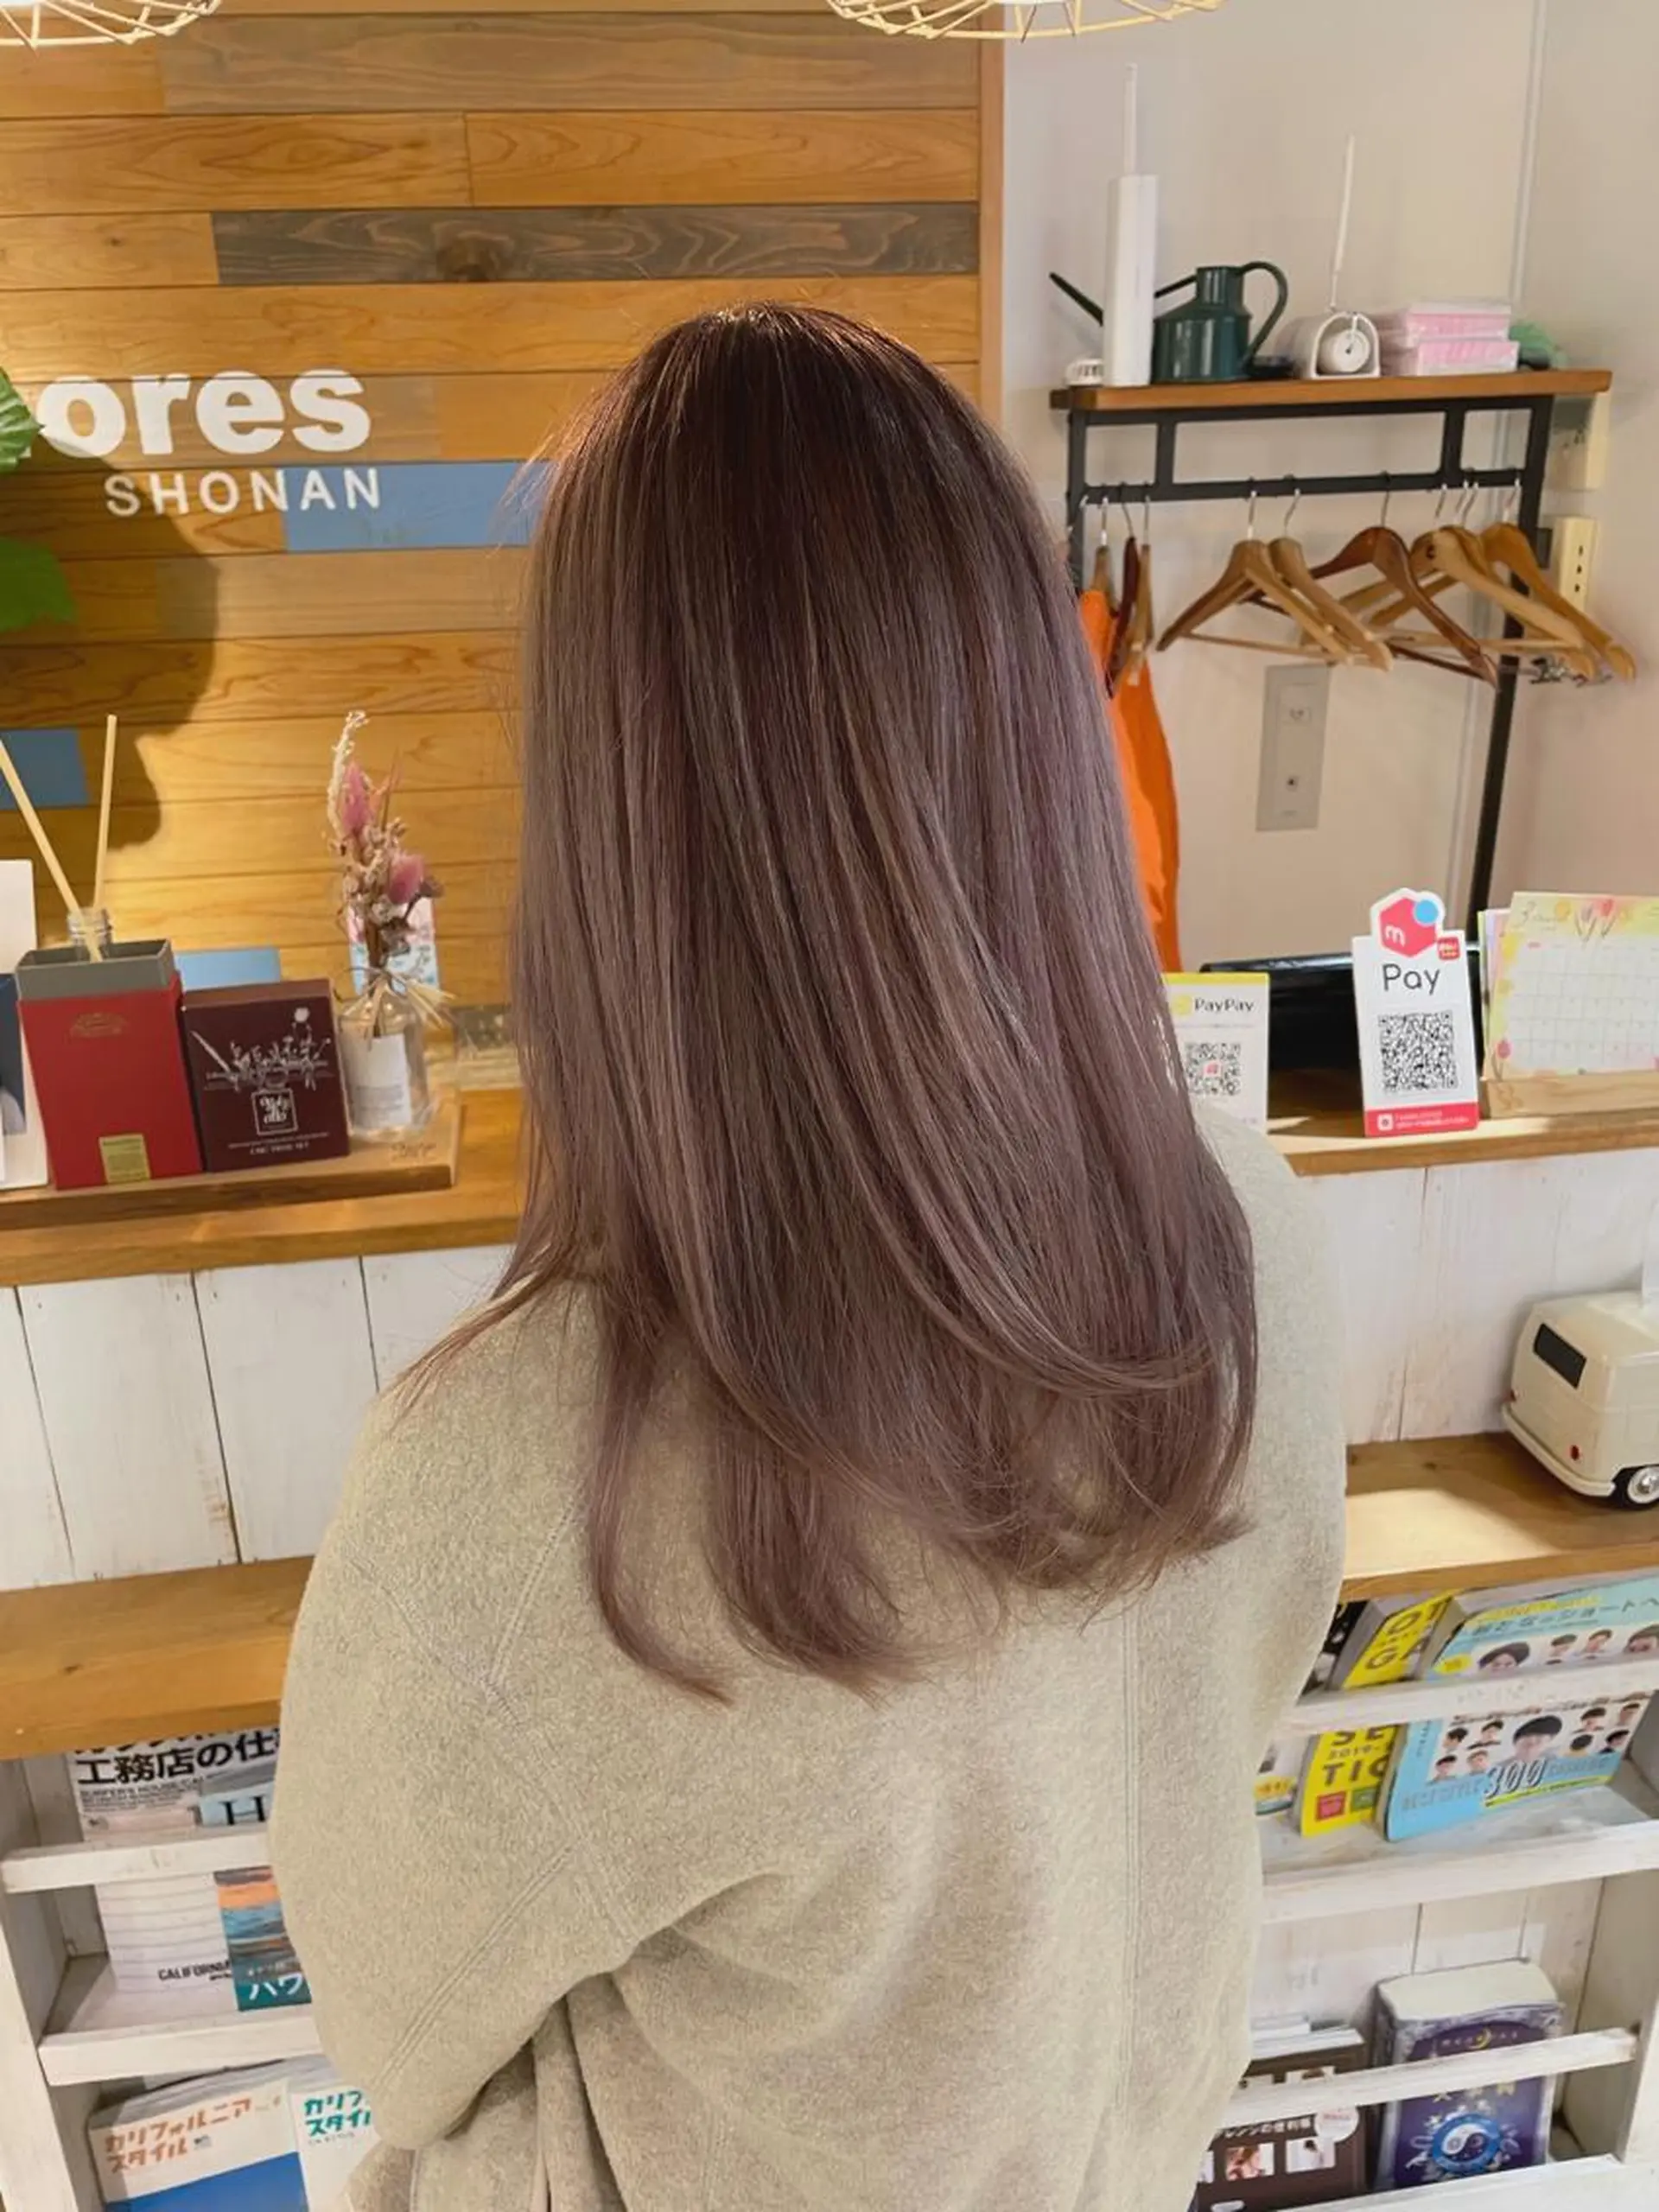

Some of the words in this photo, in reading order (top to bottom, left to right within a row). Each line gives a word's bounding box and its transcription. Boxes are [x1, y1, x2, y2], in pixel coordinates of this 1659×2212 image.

[19, 369, 372, 459] ores
[105, 467, 381, 517] SHONAN
[1382, 963, 1441, 995] Pay
[1194, 996, 1255, 1013] PayPay
[76, 1728, 280, 1785] 工務店の仕
[218, 1794, 267, 1826] H
[248, 1972, 303, 2000] ハワ
[106, 2137, 188, 2173] スタイル
